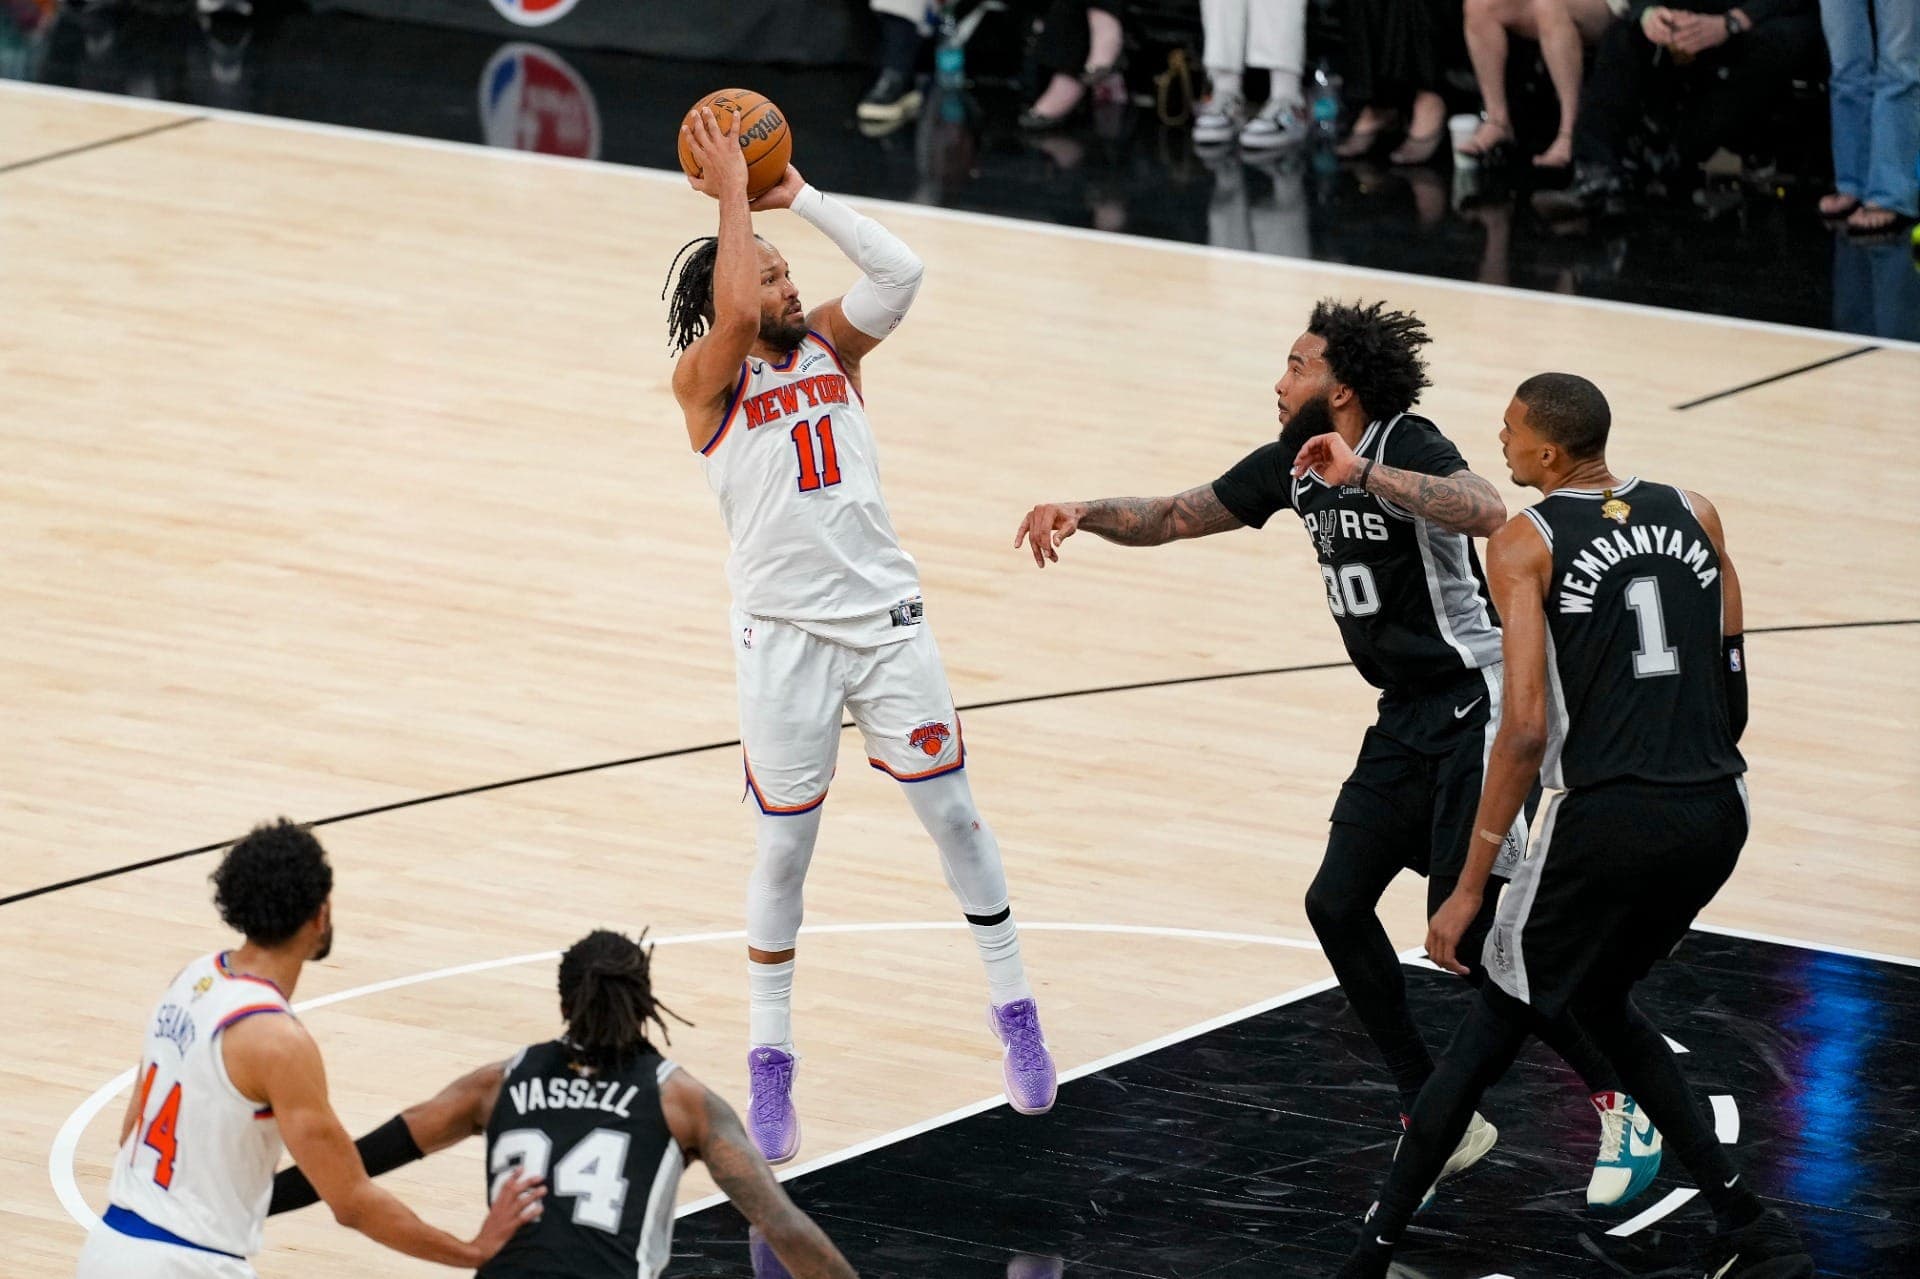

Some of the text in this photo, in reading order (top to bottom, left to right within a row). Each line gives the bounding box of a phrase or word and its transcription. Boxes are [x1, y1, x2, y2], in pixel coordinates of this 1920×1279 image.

[738, 109, 783, 148] Wilso
[742, 374, 850, 432] NEW YORK
[790, 414, 842, 493] 11
[1559, 524, 1719, 614] WEMBANYAMA
[1624, 575, 1681, 679] 1
[509, 1076, 640, 1119] VASSELL
[490, 1127, 632, 1236] 24
